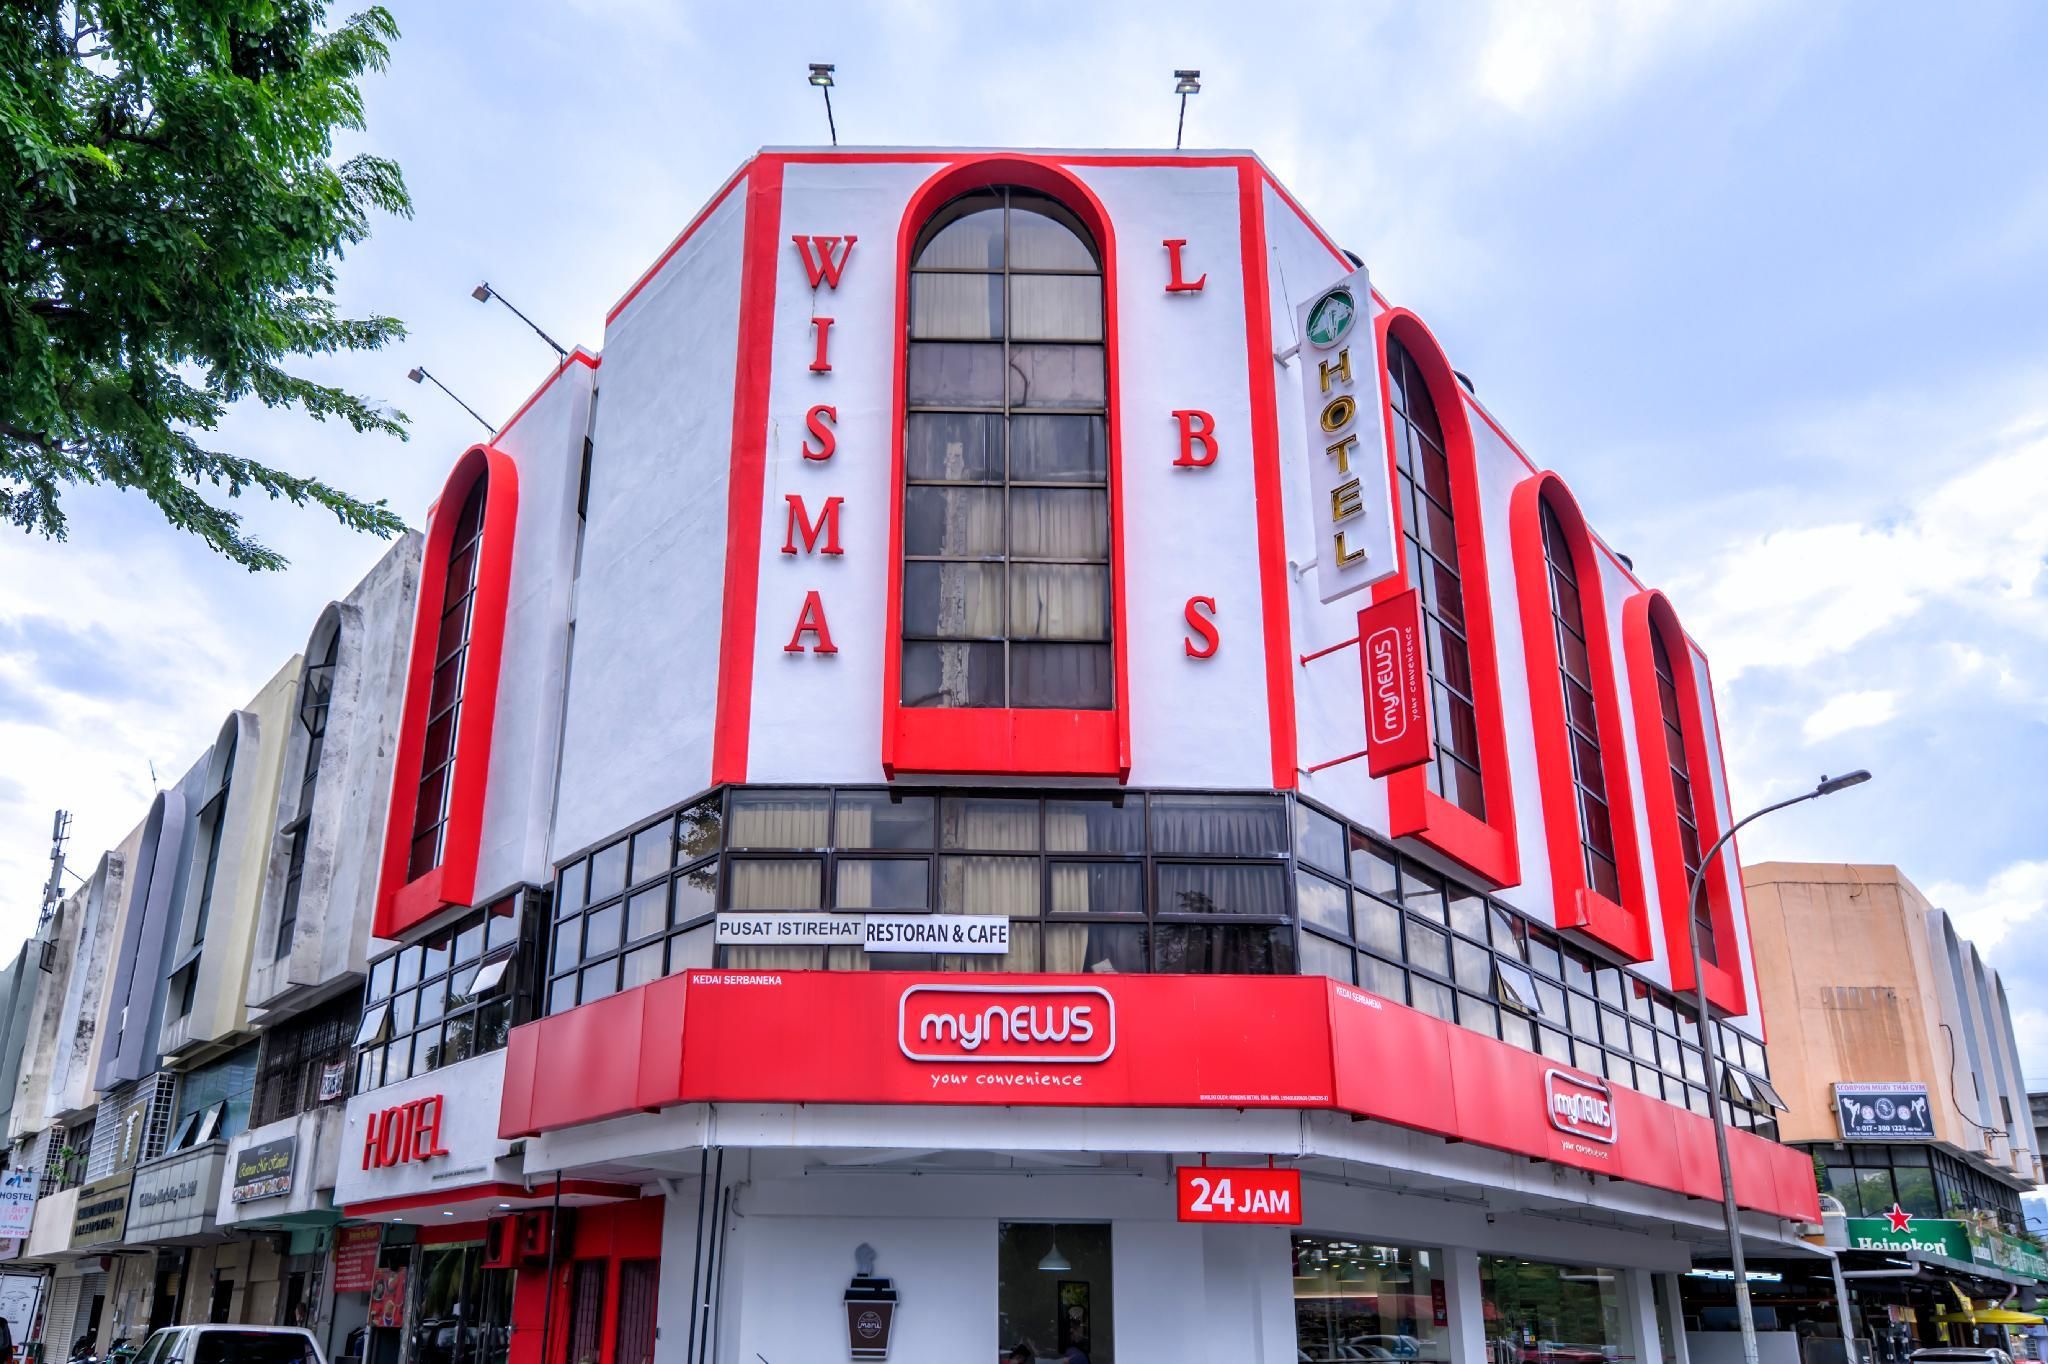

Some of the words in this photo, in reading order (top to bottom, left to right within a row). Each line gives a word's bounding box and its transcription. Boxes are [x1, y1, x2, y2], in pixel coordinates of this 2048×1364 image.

[781, 235, 858, 654] WISMA
[1162, 239, 1220, 659] LBS
[1318, 346, 1368, 570] HOTEL
[1405, 626, 1416, 693] convenience
[1411, 700, 1421, 721] your
[719, 922, 772, 936] PUSAT
[777, 922, 861, 936] ISTIREHAT
[866, 923, 948, 943] RESTORAN
[952, 923, 964, 943] &
[967, 924, 1007, 944] CAFE
[693, 975, 722, 985] KEDAI
[724, 975, 782, 986] SERBANEKA
[931, 1072, 969, 1088] your
[975, 1071, 1083, 1087] convenience
[362, 1094, 449, 1171] HOTEL
[0, 1192, 34, 1201] HOSTEL
[1190, 1177, 1235, 1213] 24
[1237, 1188, 1290, 1214] JAM
